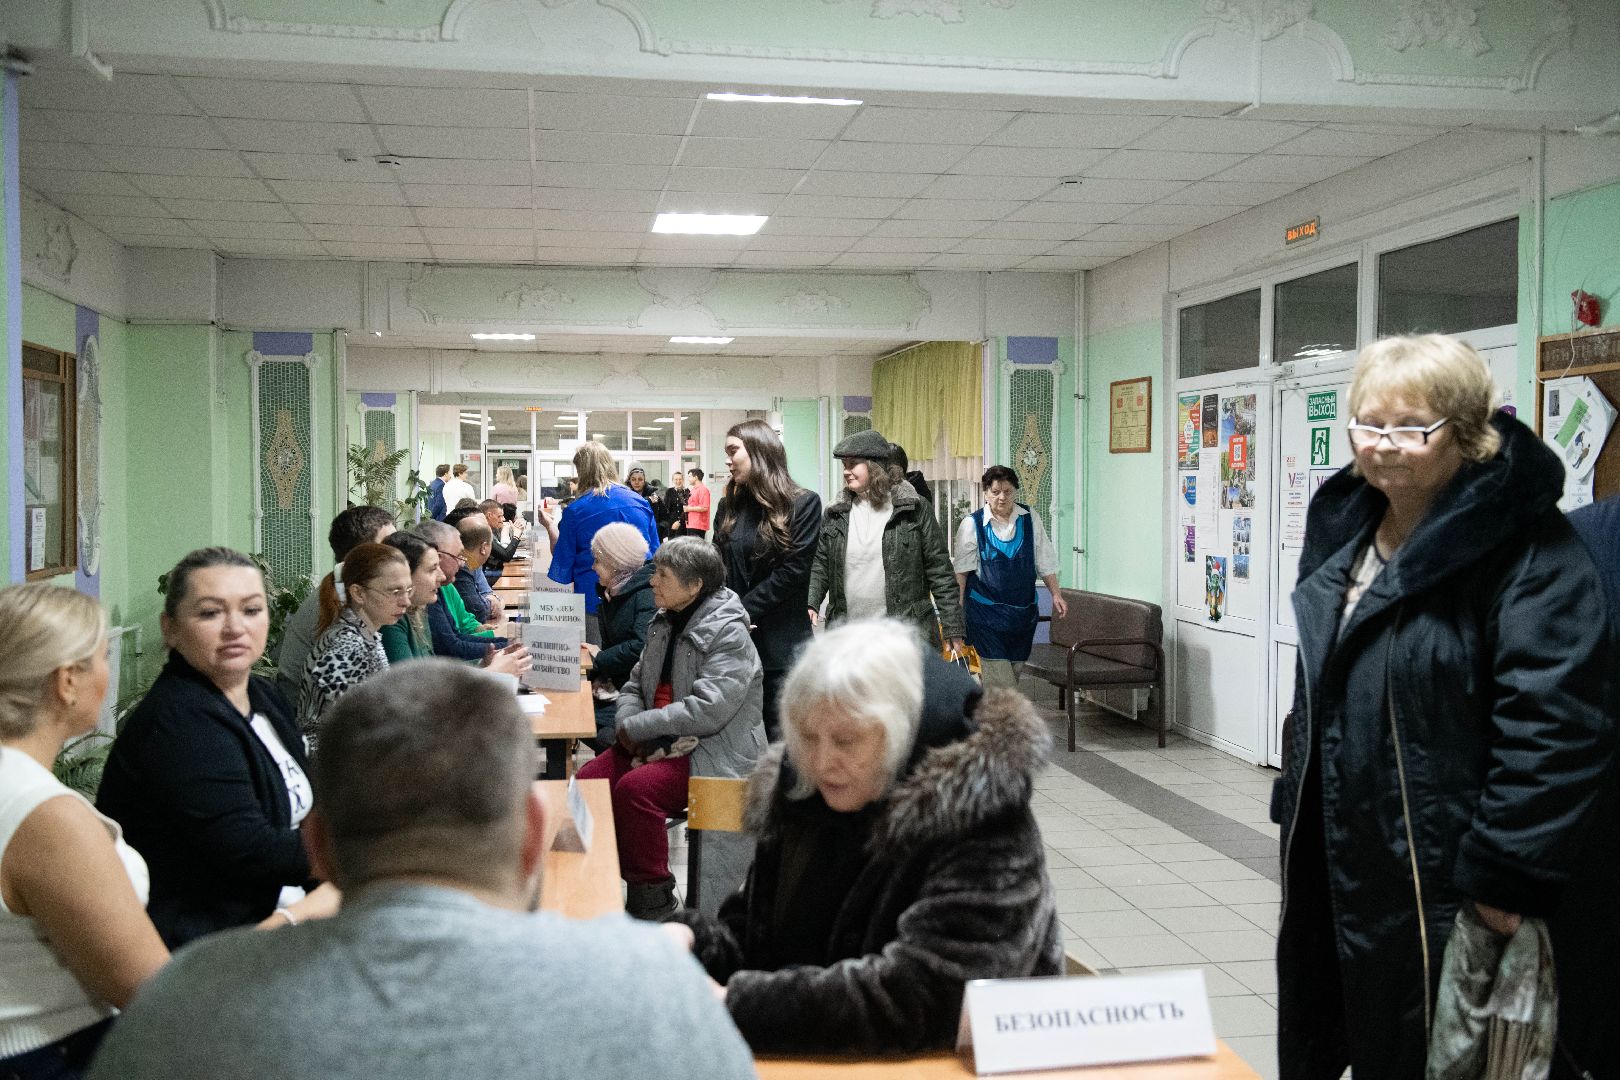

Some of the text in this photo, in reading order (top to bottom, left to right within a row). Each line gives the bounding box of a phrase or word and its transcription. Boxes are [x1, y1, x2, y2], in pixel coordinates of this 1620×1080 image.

[1287, 222, 1316, 241] ВЫХОД
[1308, 394, 1336, 405] ЗАПАСНЫЙ
[1308, 403, 1336, 417] ВЫХОД
[540, 604, 554, 612] МБУ
[994, 1000, 1185, 1034] БЕЗОПАСНОСТЬ
